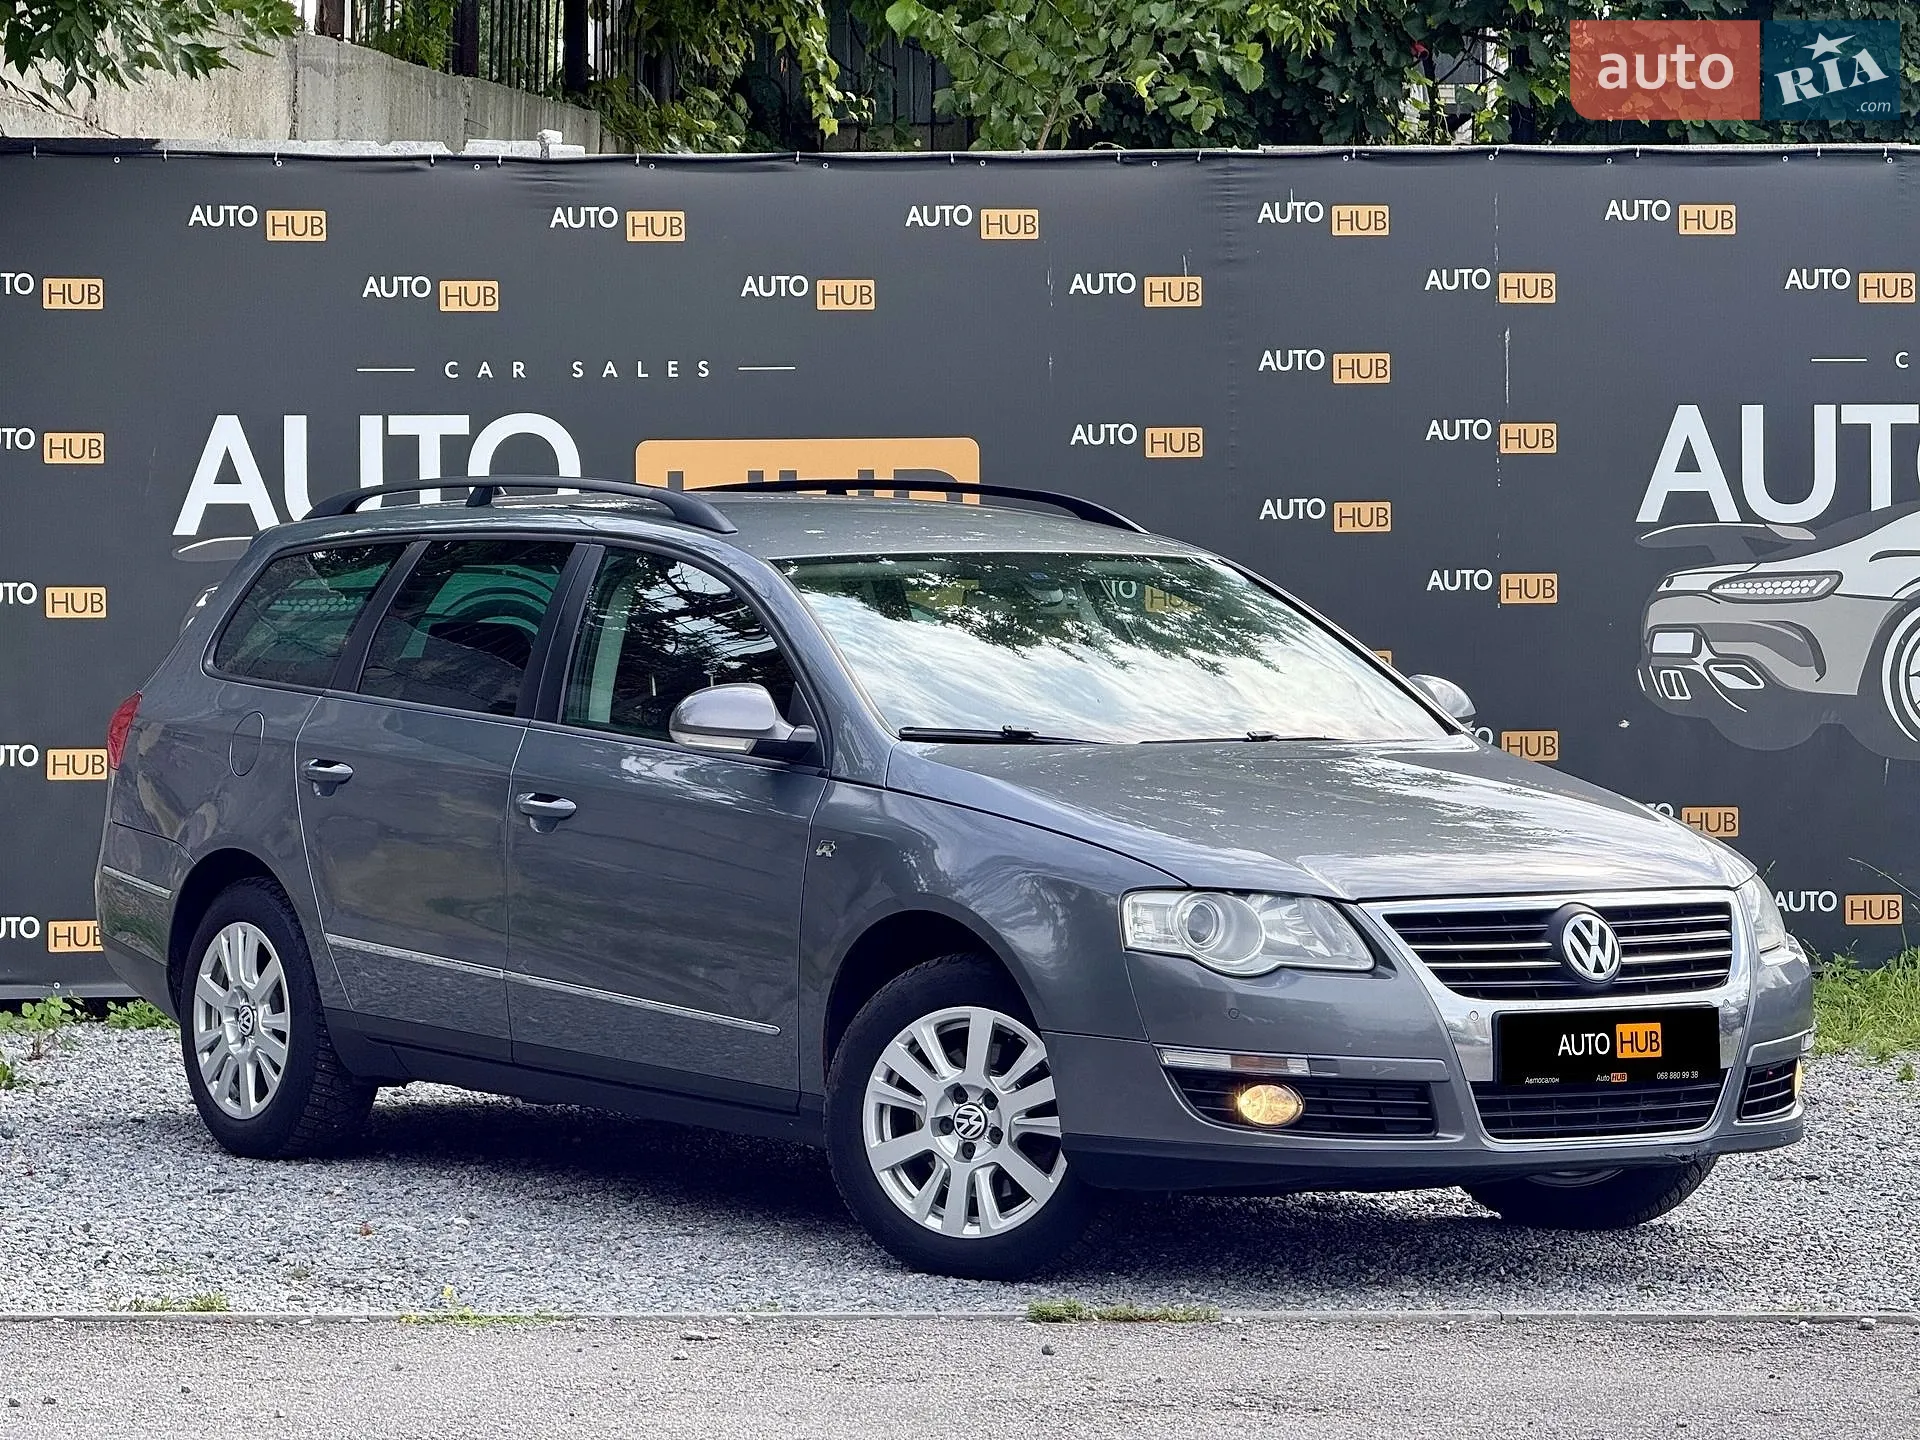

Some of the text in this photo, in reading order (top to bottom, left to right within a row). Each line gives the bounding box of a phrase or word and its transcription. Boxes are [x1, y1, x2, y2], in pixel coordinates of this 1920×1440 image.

[189, 204, 323, 237] AUTO HUB
[550, 206, 682, 237] AUTO HUB
[905, 204, 1037, 235] AUTO HUB
[1257, 201, 1388, 231] AUTO HUB
[1605, 199, 1734, 230] AUTO HUB
[0, 272, 100, 305] TO HUB
[363, 275, 496, 307] AUTO HUB
[742, 274, 873, 306] AUTO HUB
[1069, 272, 1200, 303] AUTO HUB
[1425, 268, 1553, 299] AUTO HUB
[1785, 267, 1913, 298] AUTO HUB
[444, 360, 710, 379] CAR SALES
[1259, 348, 1388, 380] AUTO HUB
[0, 427, 101, 460] TO HUB
[1070, 423, 1200, 454] AUTO HUB
[1425, 418, 1554, 449] AUTO HUB
[172, 412, 582, 535] AUTO
[1635, 404, 1920, 523] AUT
[1259, 497, 1388, 528] AUTO HUB
[0, 581, 103, 614] TO HUB
[1426, 568, 1555, 600] AUTO HUB
[0, 744, 105, 776] TO HUB
[1506, 735, 1556, 757] HUB
[1686, 811, 1737, 832] HUB
[1774, 890, 1900, 921] AUTO HUB
[0, 916, 41, 939] TO
[1557, 1030, 1661, 1057] AUTO HUB
[1596, 1074, 1610, 1082] Auto
[1681, 1071, 1690, 1079] 99
